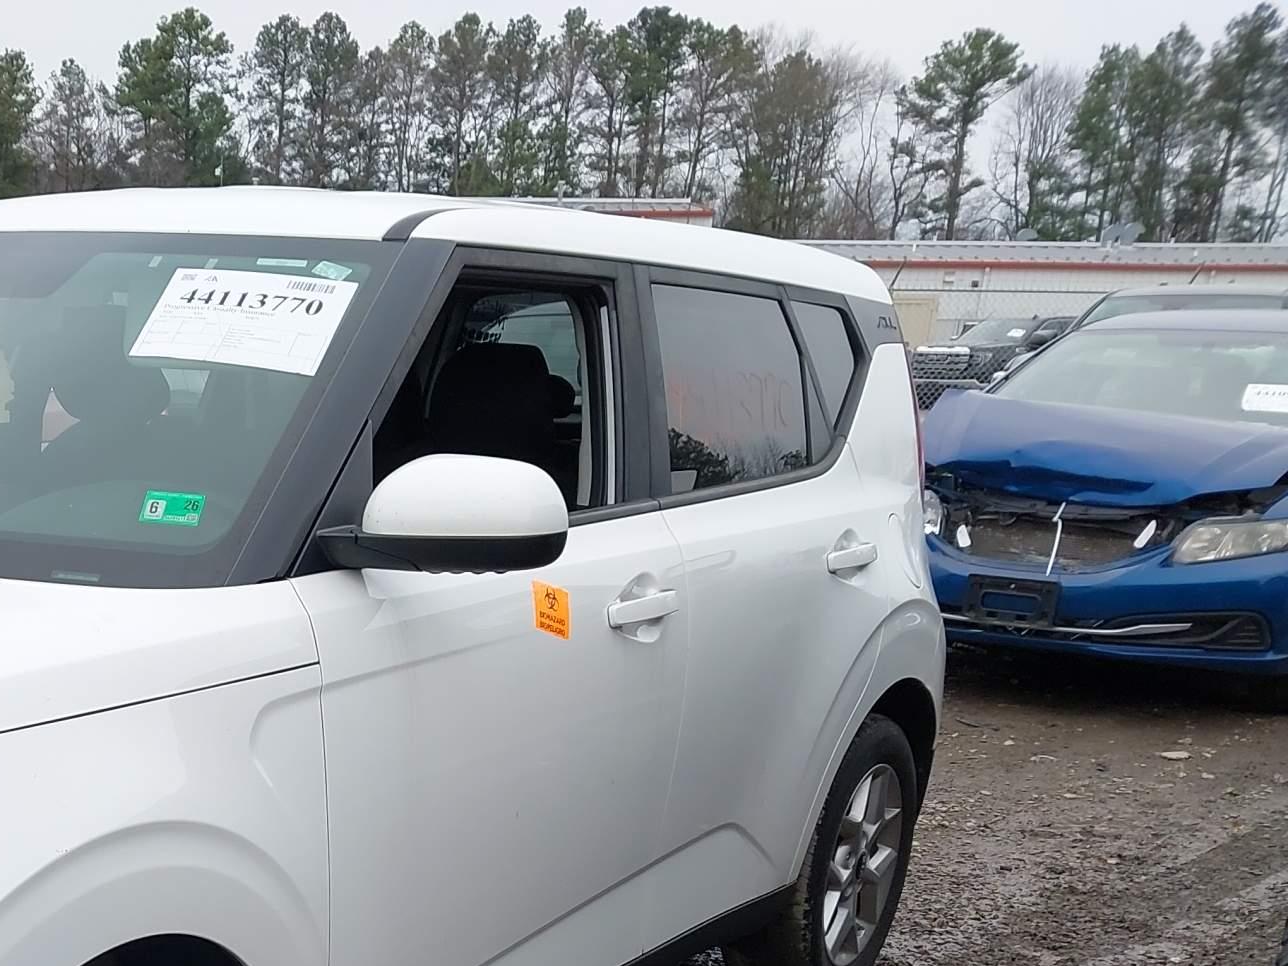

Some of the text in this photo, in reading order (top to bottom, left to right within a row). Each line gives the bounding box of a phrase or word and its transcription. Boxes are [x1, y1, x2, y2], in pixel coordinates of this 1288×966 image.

[180, 288, 324, 316] 44113770
[149, 500, 199, 514] 6 26
